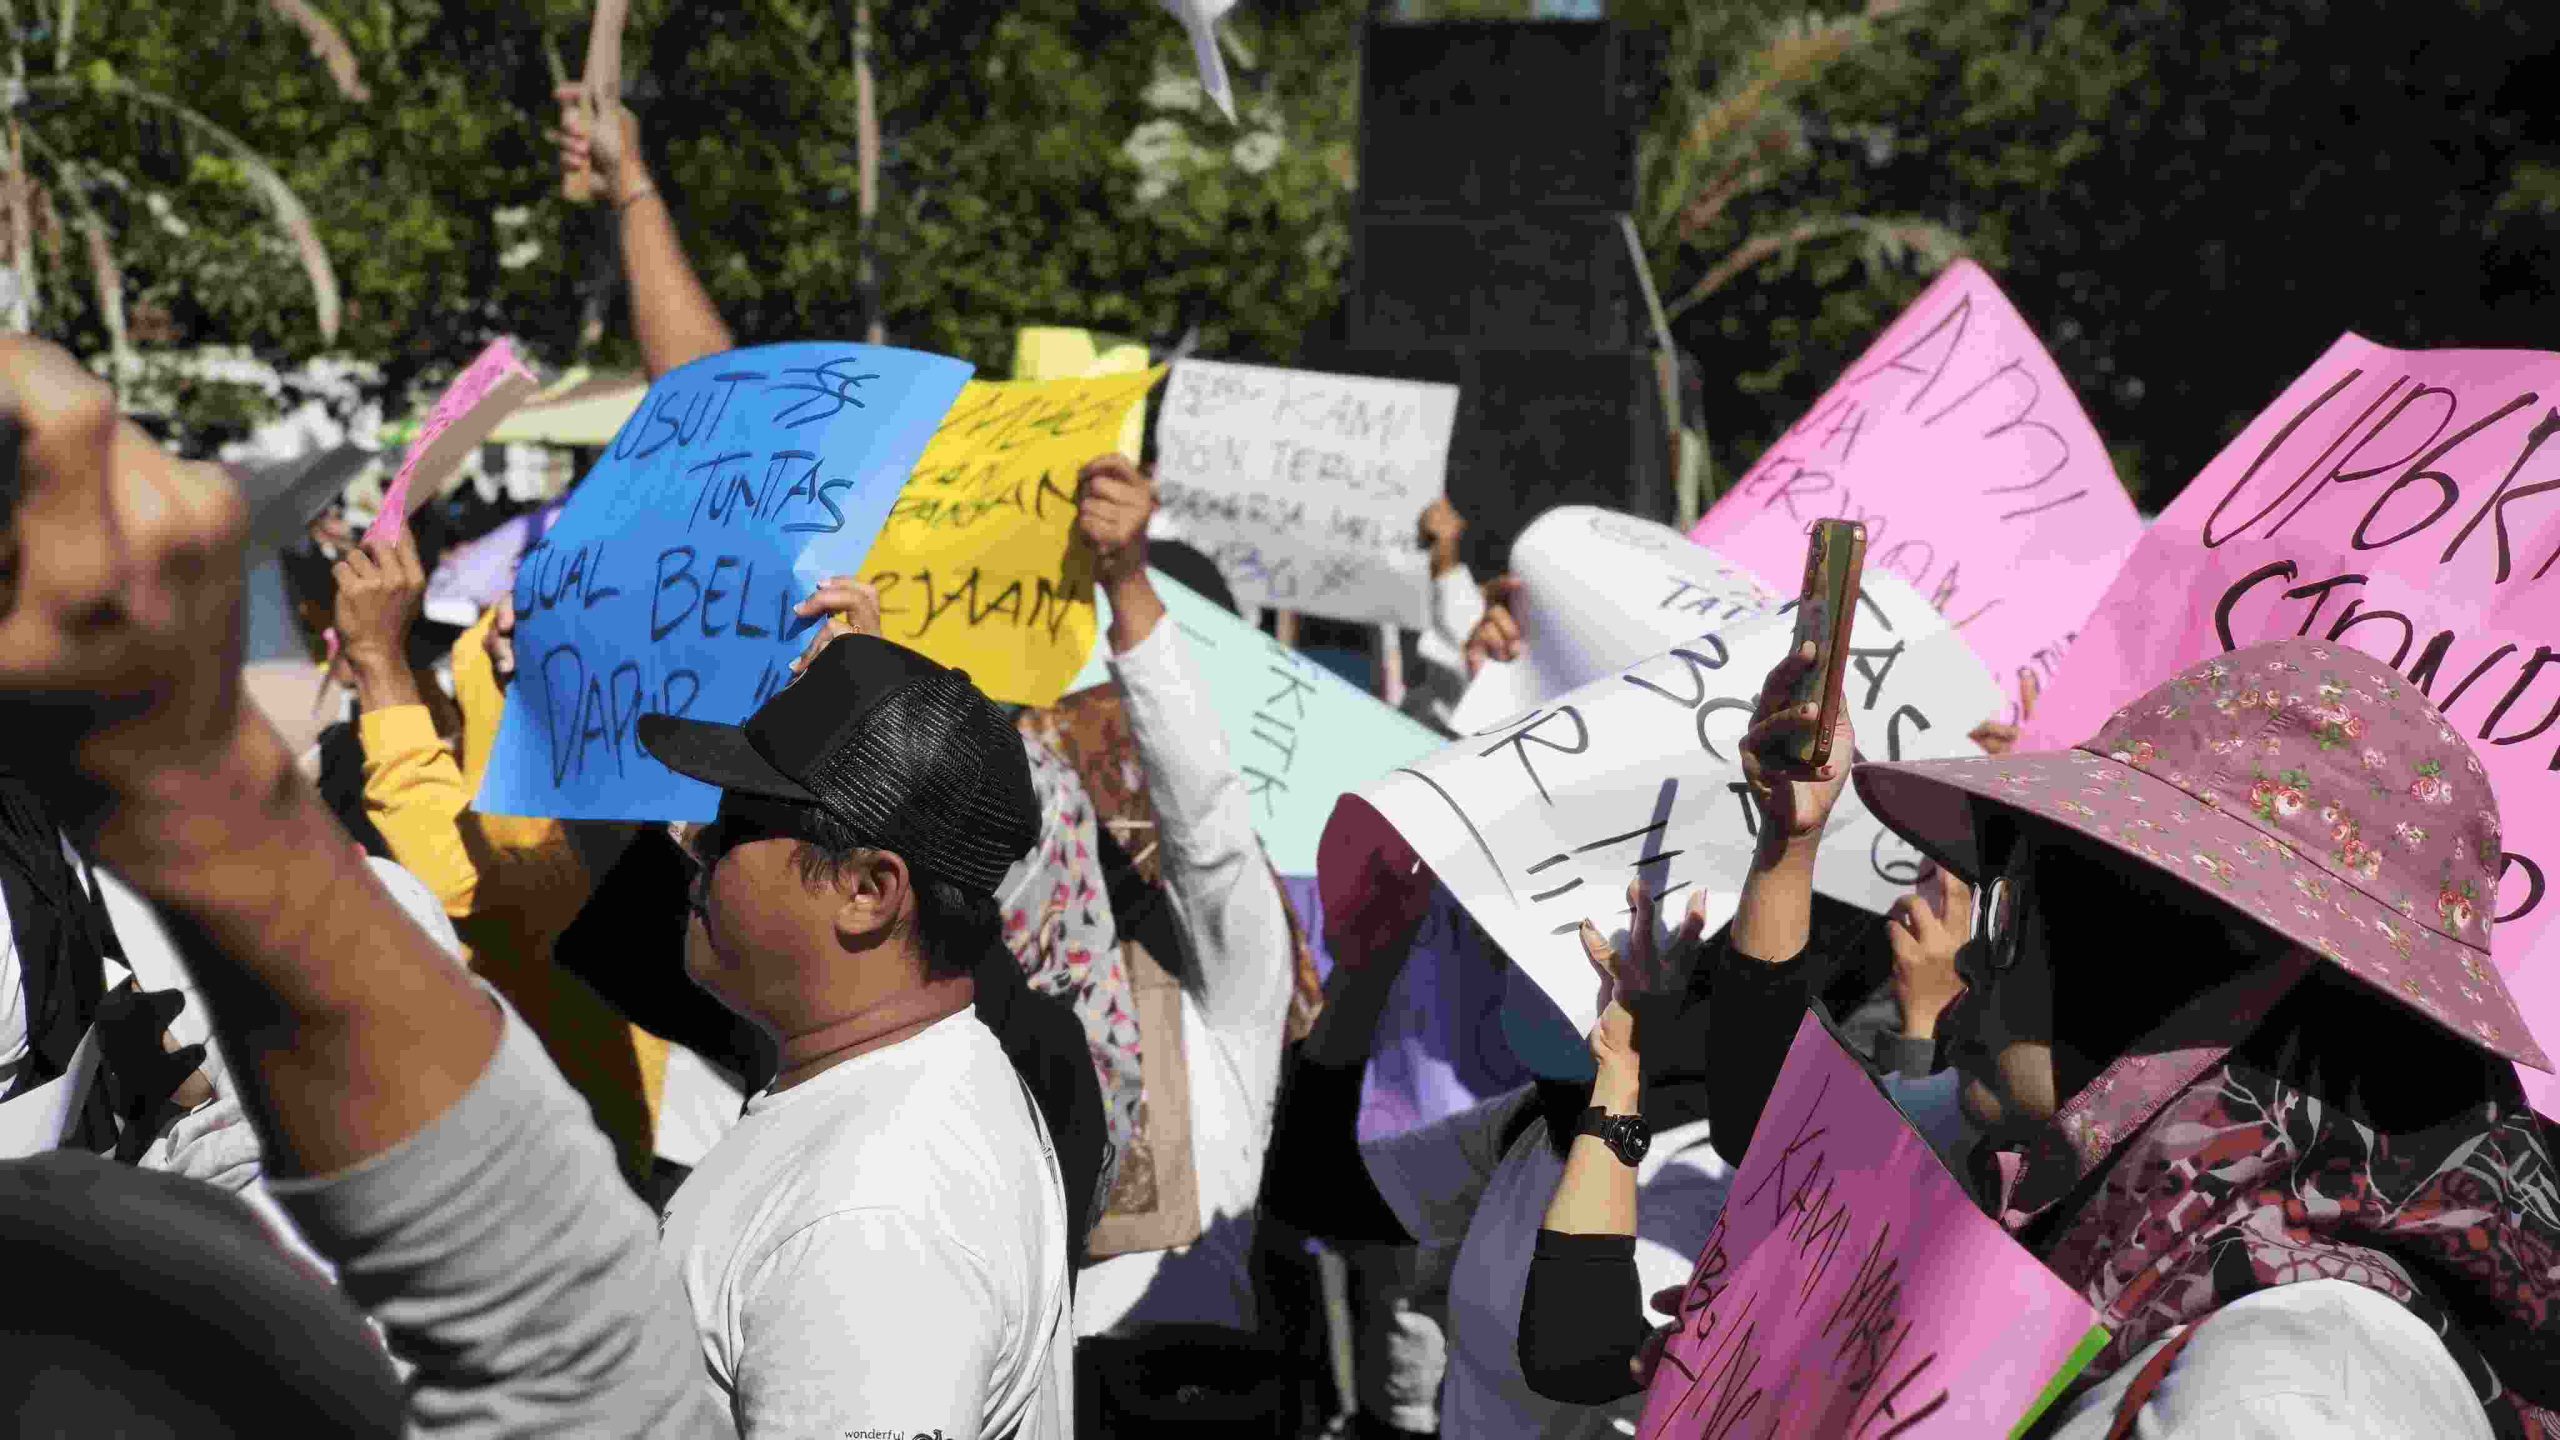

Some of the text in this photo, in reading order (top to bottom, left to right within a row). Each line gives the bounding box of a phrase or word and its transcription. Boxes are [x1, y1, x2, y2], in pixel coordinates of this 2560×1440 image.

[614, 369, 770, 461] USUT
[686, 450, 857, 534] TUNTAS
[844, 1428, 904, 1440] wonderful
